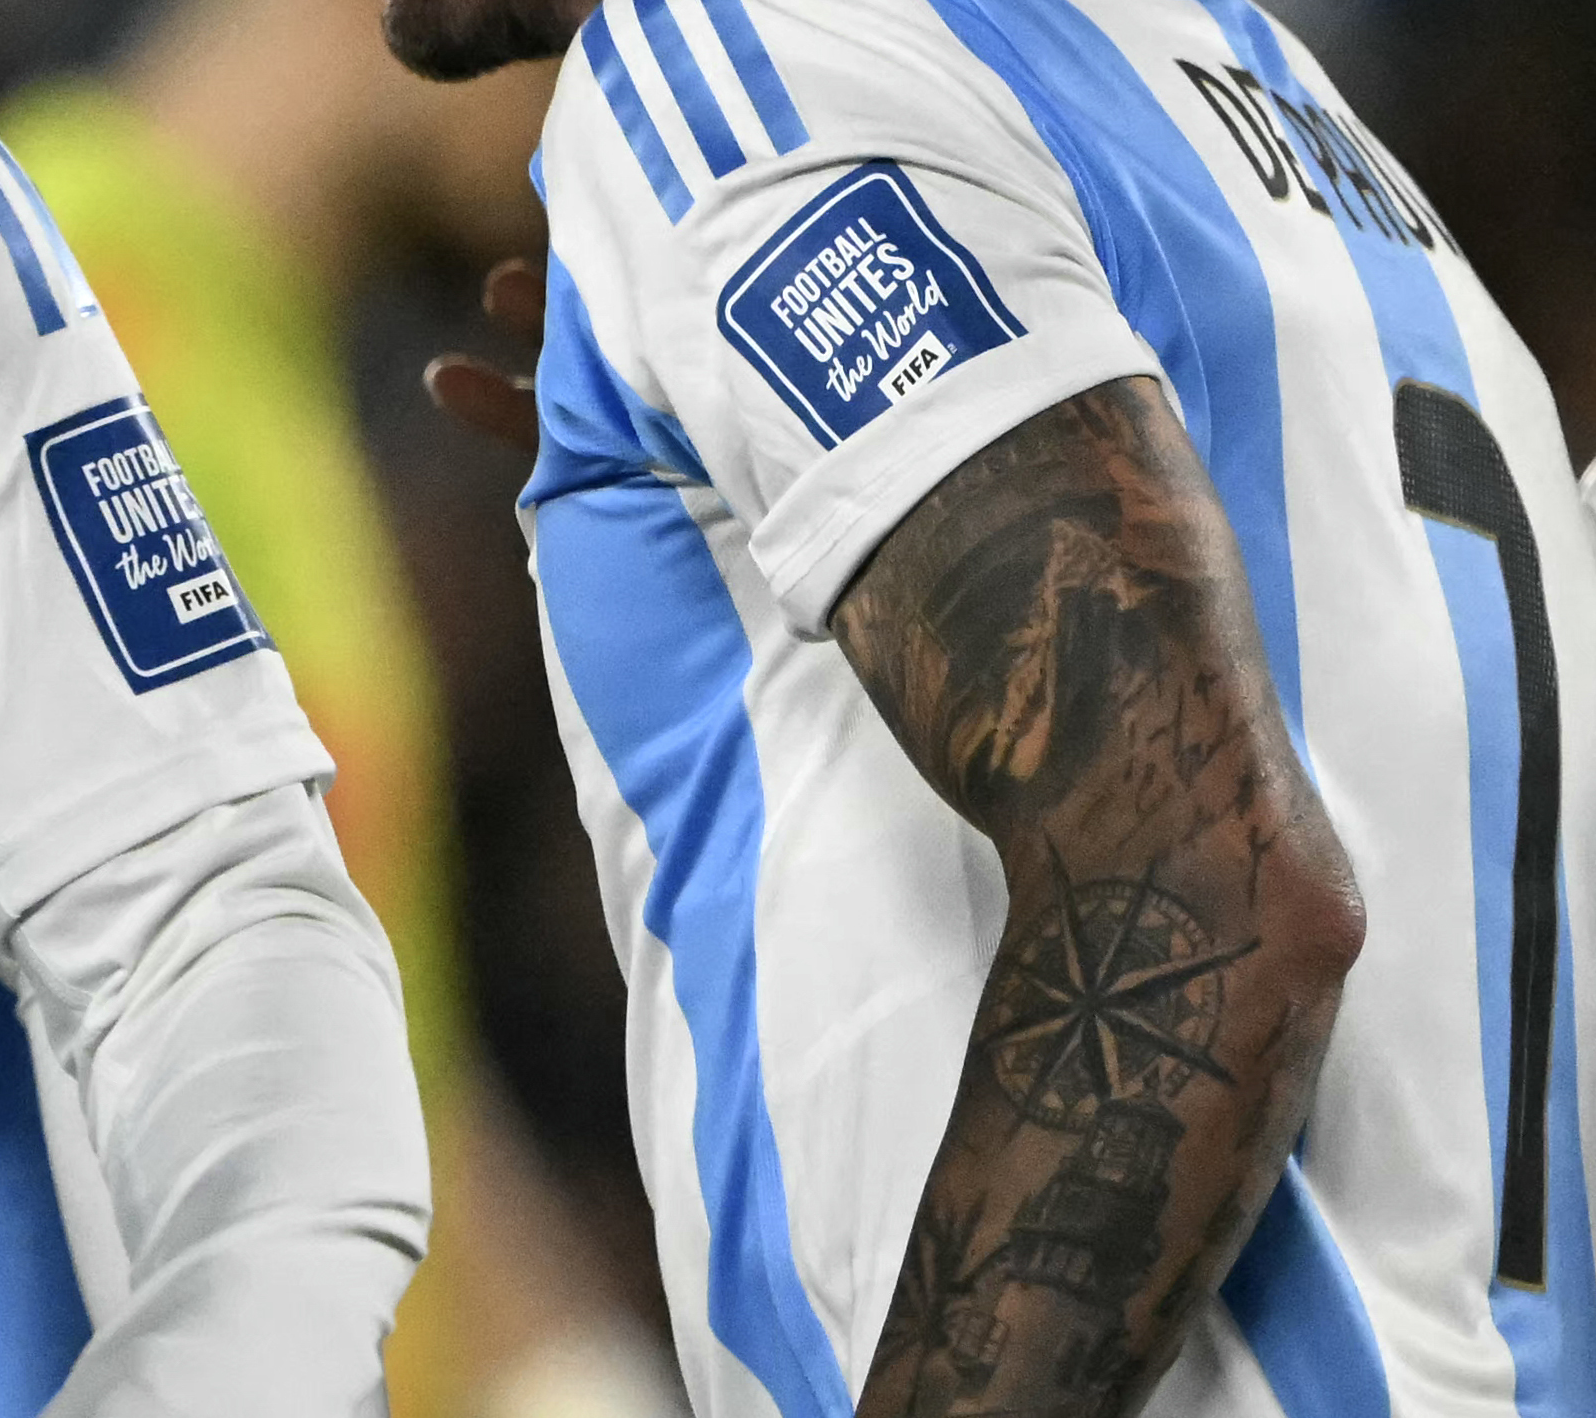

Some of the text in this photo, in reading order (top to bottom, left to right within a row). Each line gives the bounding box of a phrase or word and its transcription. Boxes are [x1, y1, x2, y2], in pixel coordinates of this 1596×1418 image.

[770, 217, 887, 329] FOOTBALL
[794, 243, 915, 363] UNITES
[826, 269, 949, 402] the World
[891, 347, 939, 397] FIFA
[81, 439, 181, 498] FOOTBA
[98, 473, 203, 544] UNITE
[115, 544, 168, 591] the
[179, 579, 230, 612] FIFA
[1393, 378, 1562, 1291] 7
